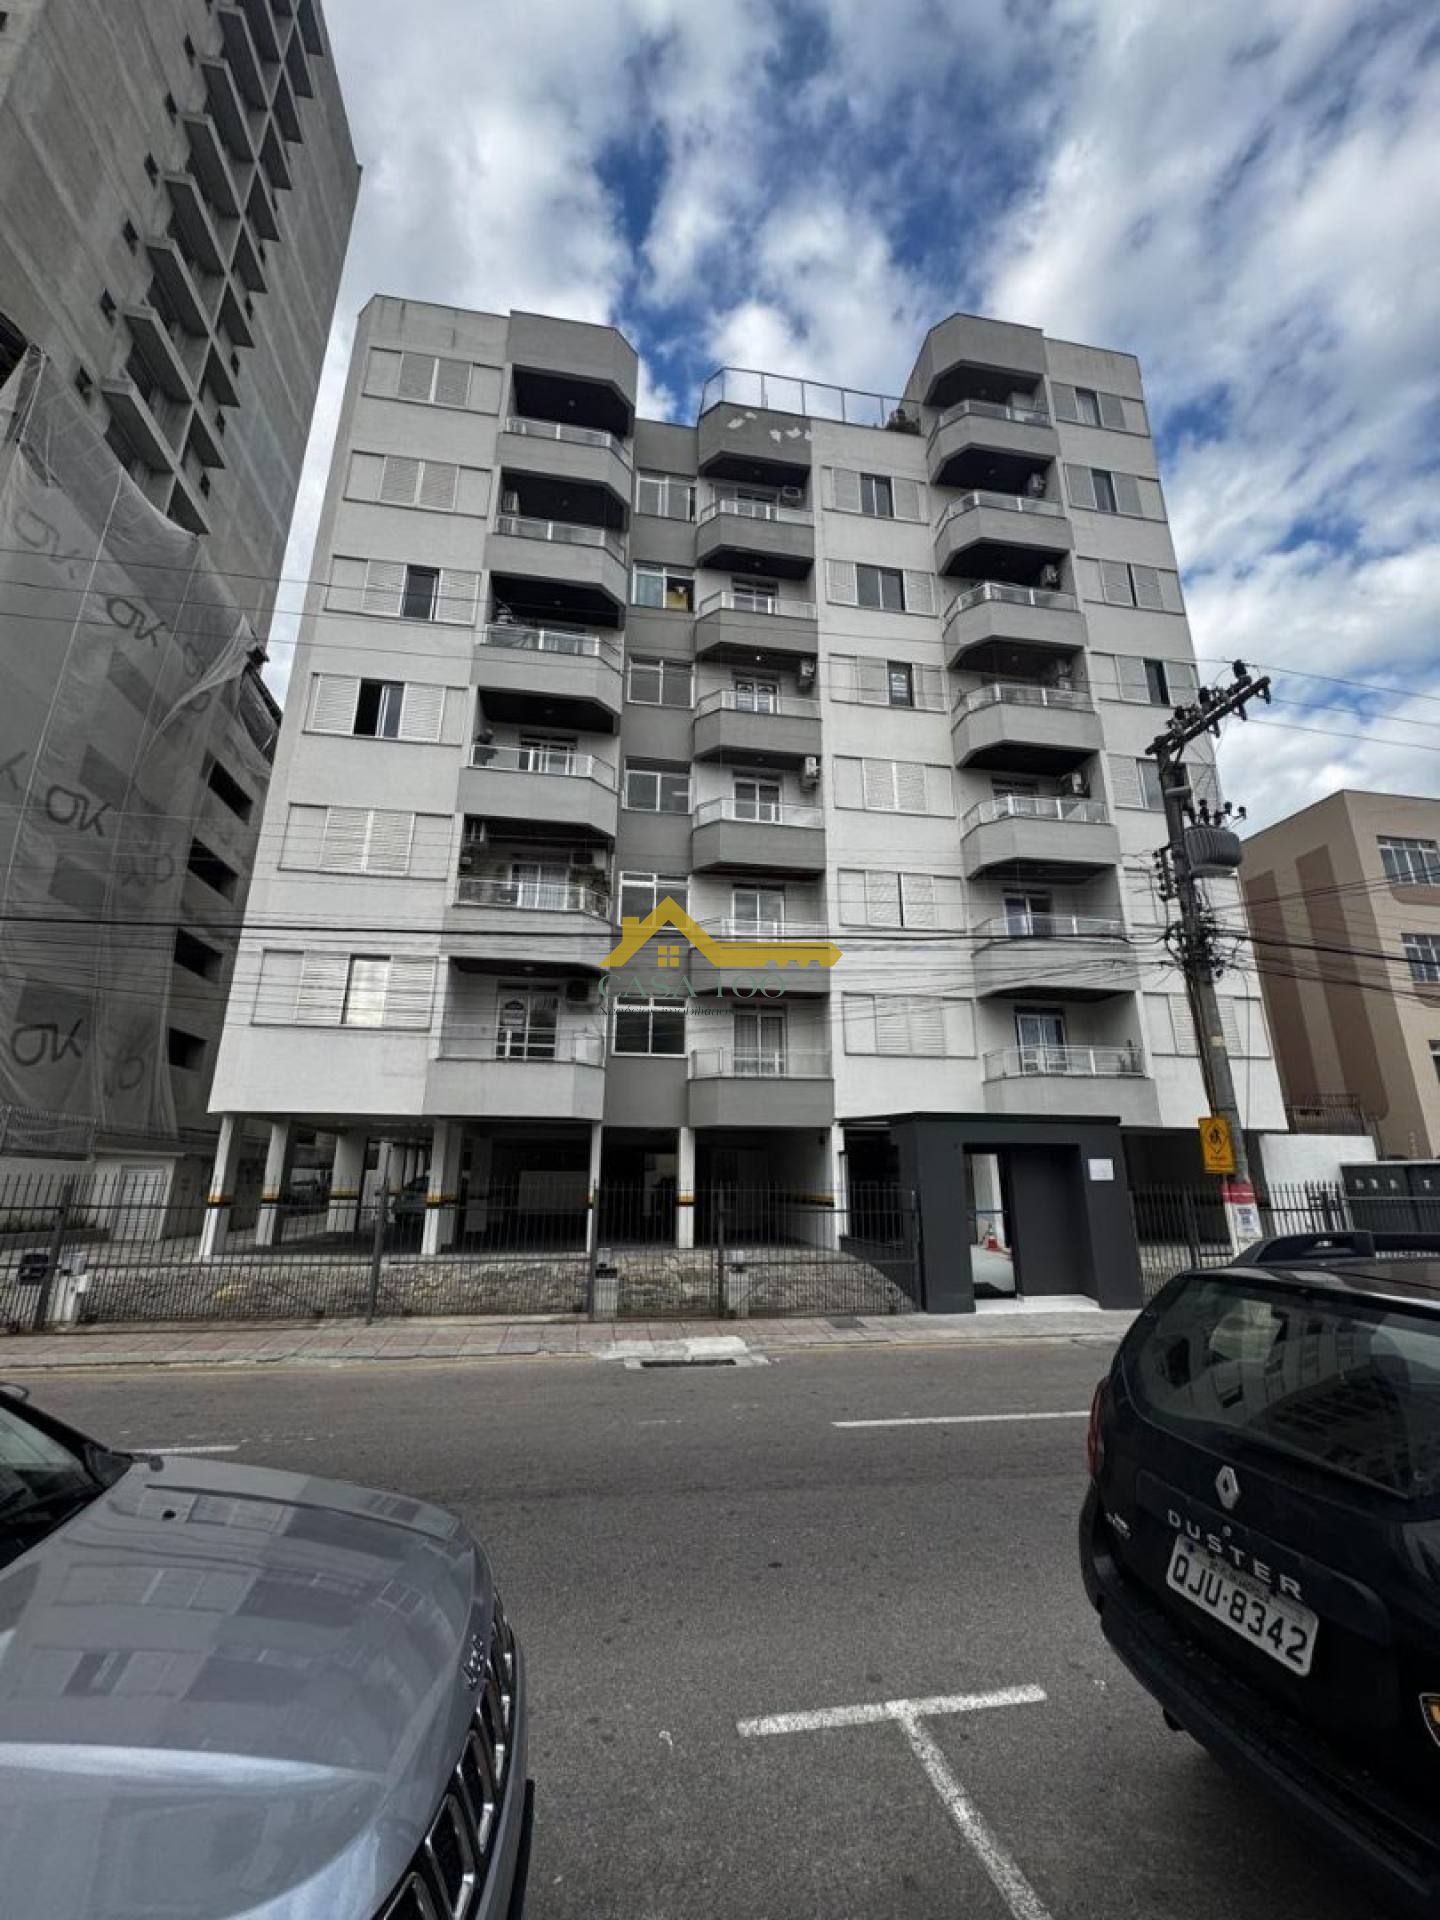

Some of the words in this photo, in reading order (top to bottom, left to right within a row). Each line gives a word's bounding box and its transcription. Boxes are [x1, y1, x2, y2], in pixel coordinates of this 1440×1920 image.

[106, 597, 166, 648] OK
[46, 784, 111, 837] OK
[11, 1018, 82, 1067] OK
[1168, 1509, 1303, 1600] DUSTER
